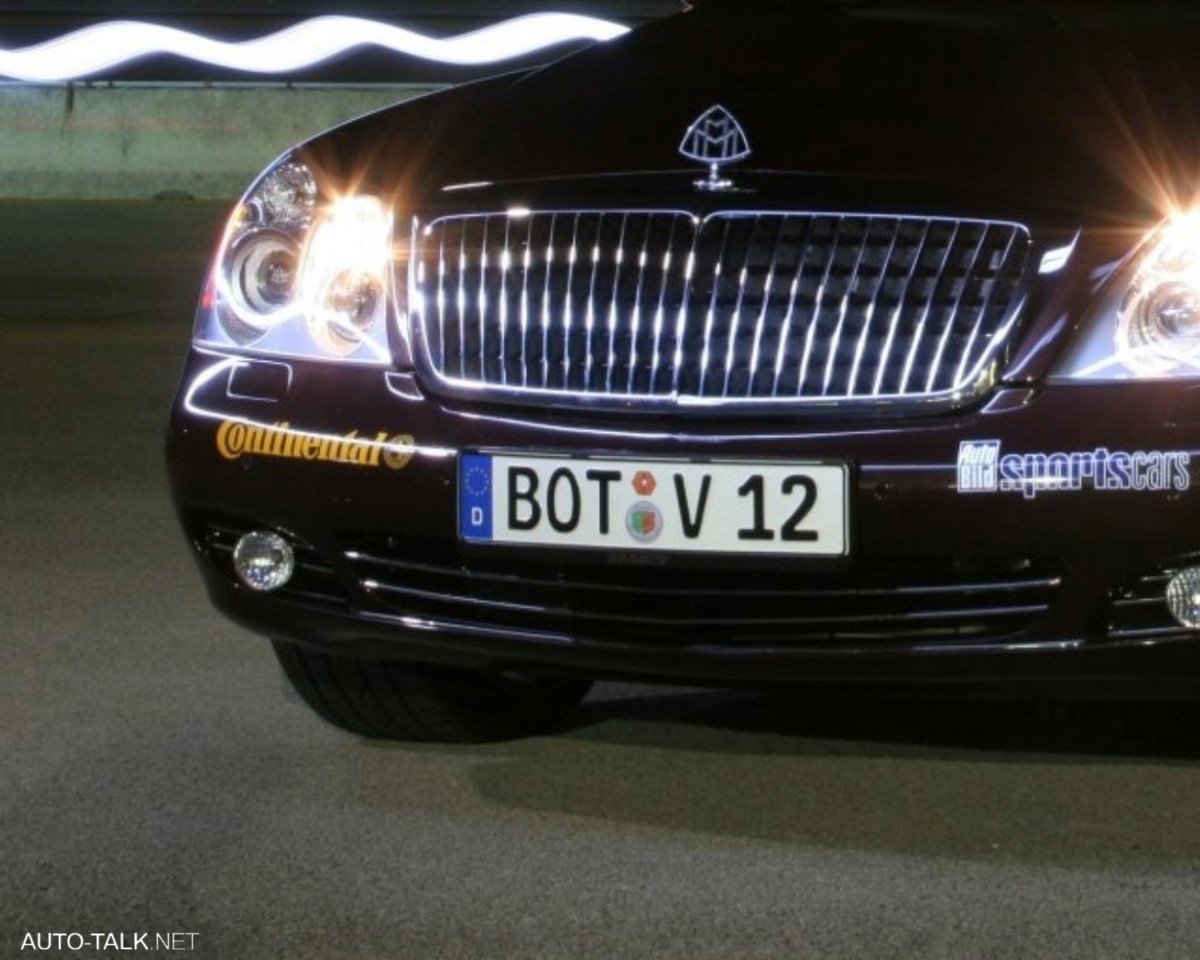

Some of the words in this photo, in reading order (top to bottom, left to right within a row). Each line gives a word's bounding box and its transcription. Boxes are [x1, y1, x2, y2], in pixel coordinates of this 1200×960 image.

[1001, 448, 1189, 499] sportscars
[470, 506, 483, 526] D
[506, 466, 621, 535] BOT
[673, 473, 711, 539] V
[737, 474, 819, 541] 12
